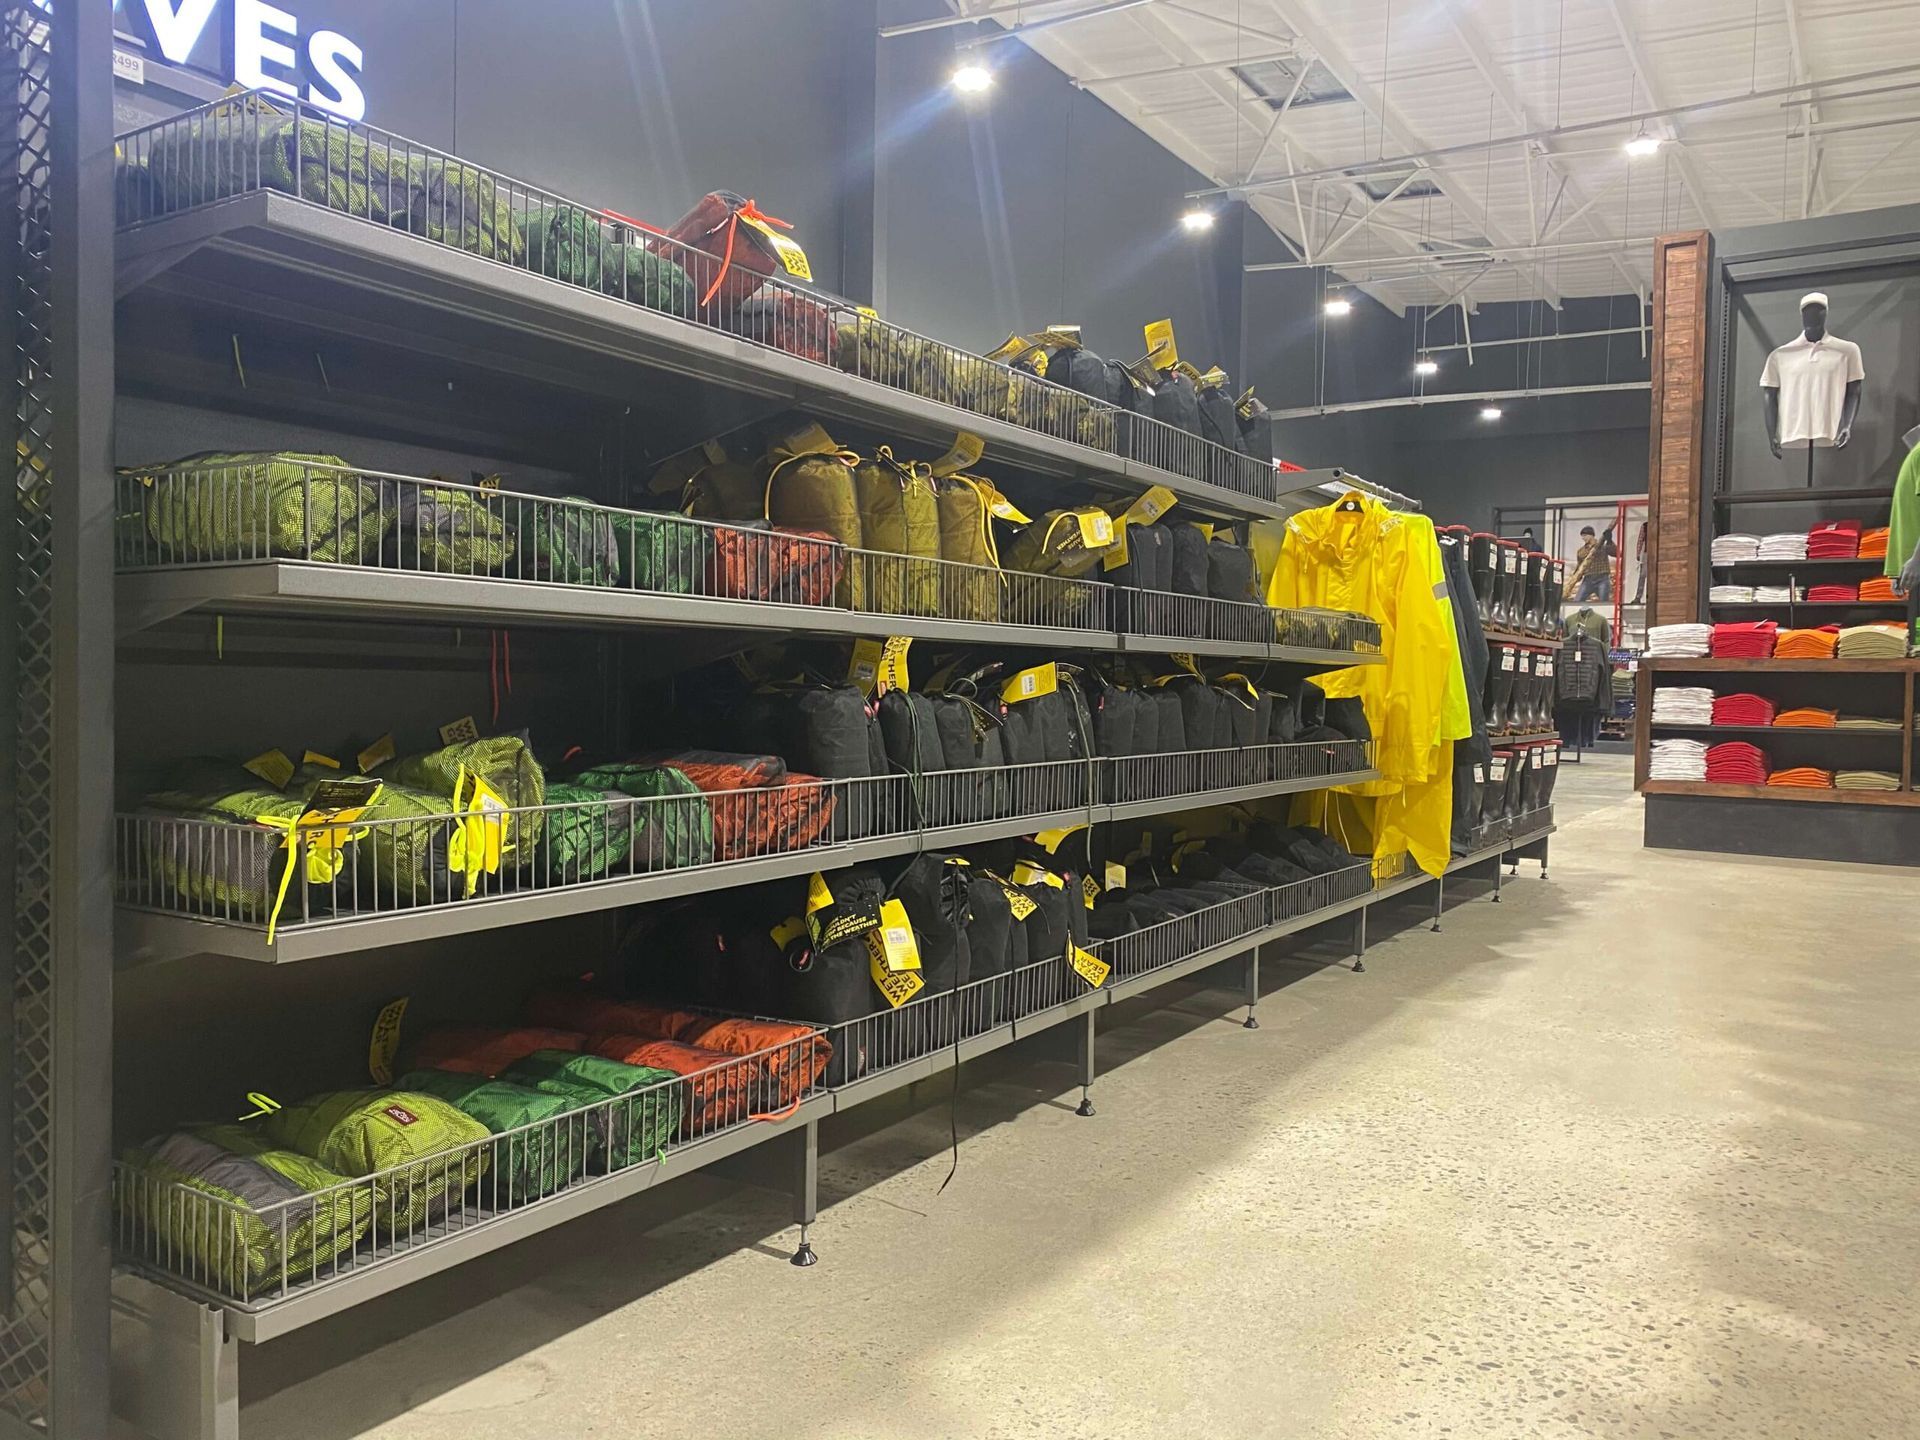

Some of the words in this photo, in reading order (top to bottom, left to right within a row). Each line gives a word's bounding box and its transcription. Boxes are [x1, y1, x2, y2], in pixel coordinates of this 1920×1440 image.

[112, 0, 366, 123] VES
[828, 913, 857, 931] OULDN'T
[837, 916, 867, 931] BECAUSE
[844, 919, 878, 934] WEATHER
[868, 941, 909, 997] WEATHER
[1075, 959, 1101, 981] WEAT
[1080, 956, 1105, 975] GEAR
[880, 976, 901, 1003] WET
